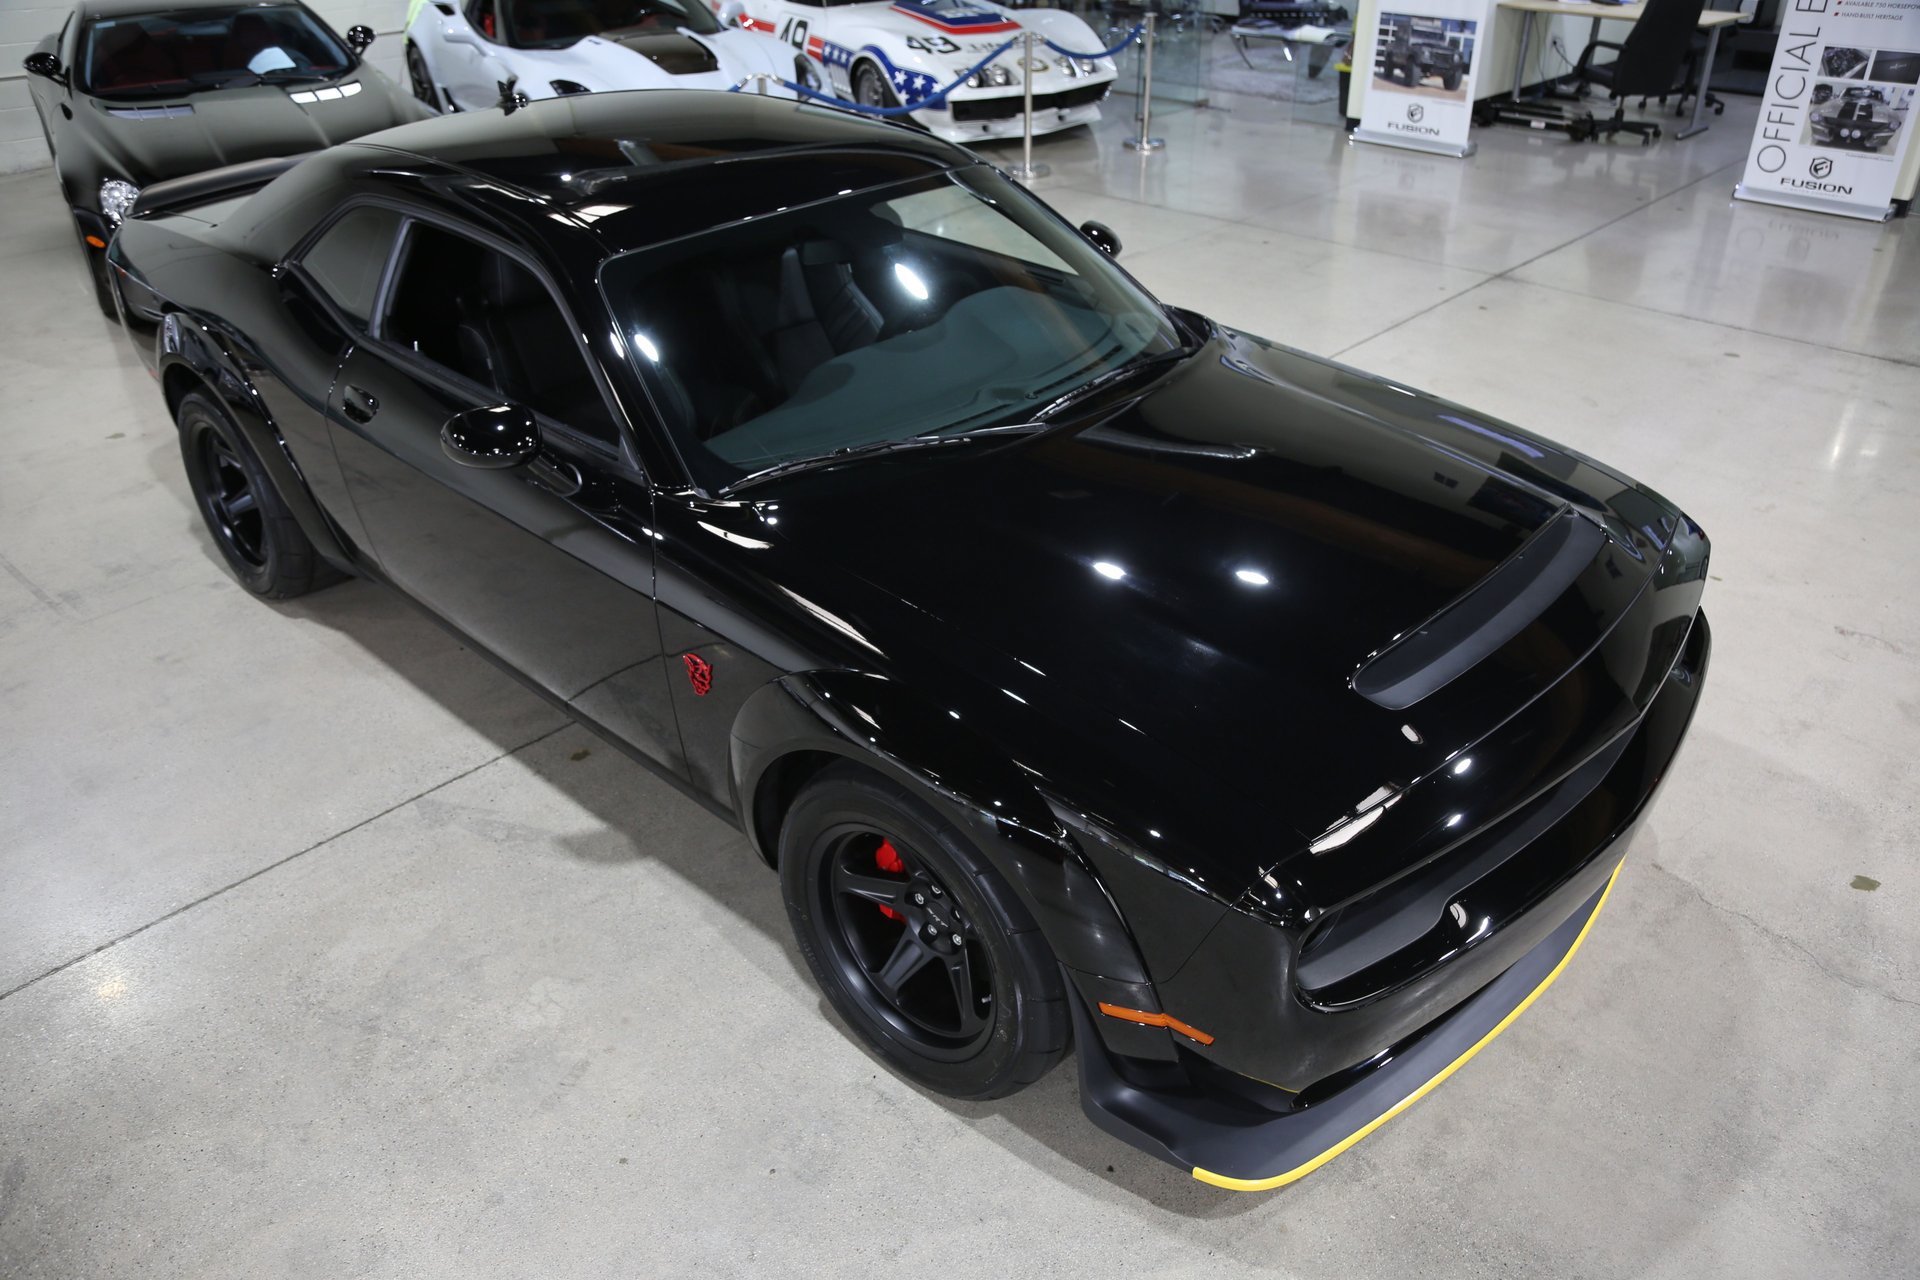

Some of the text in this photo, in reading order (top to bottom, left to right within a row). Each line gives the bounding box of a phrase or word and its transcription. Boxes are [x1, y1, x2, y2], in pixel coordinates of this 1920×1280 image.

[906, 36, 962, 54] 49
[1757, 26, 1821, 174] OFFICIAL
[1387, 121, 1440, 136] FUSION
[1780, 177, 1853, 195] FUSION
